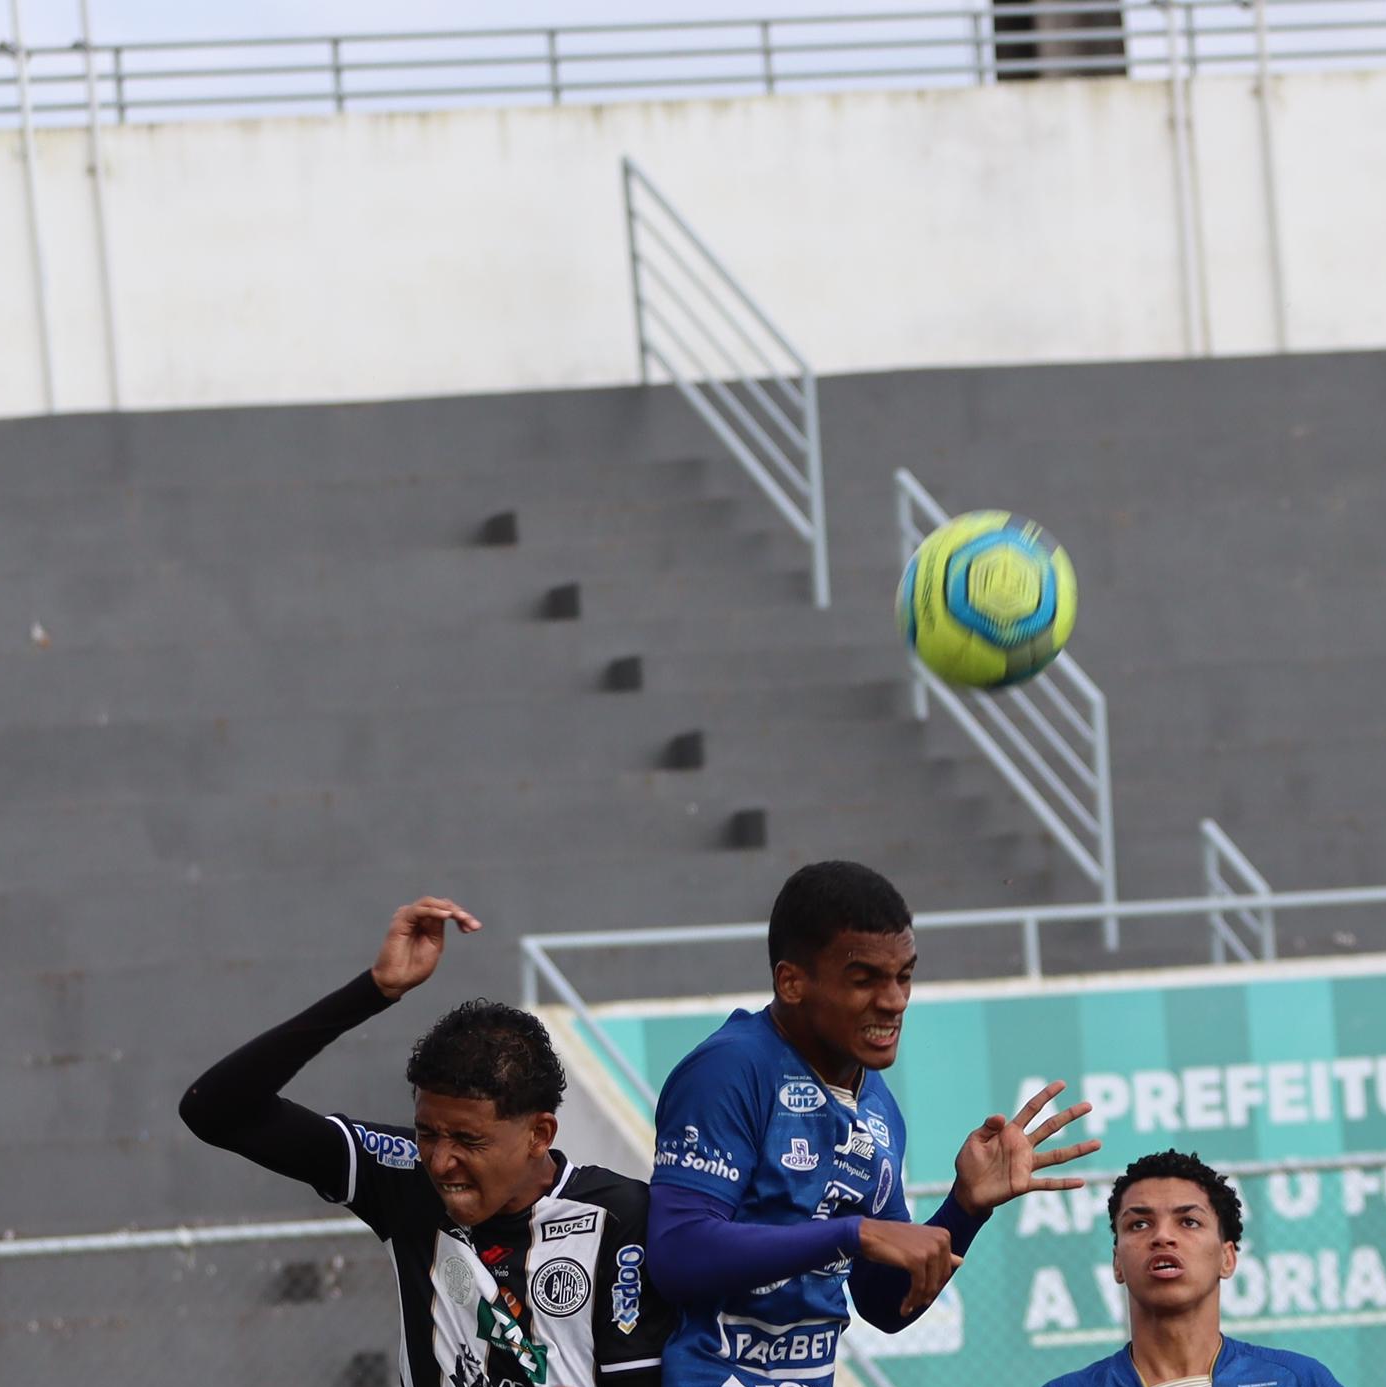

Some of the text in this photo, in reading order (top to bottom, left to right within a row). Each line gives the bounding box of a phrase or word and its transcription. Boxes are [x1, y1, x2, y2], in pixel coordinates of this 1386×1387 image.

[787, 1096, 819, 1109] LUIZ
[680, 1151, 740, 1181] Sonho
[615, 1246, 643, 1311] Oops
[1024, 1265, 1080, 1331] A
[736, 1330, 835, 1364] PAGBET
